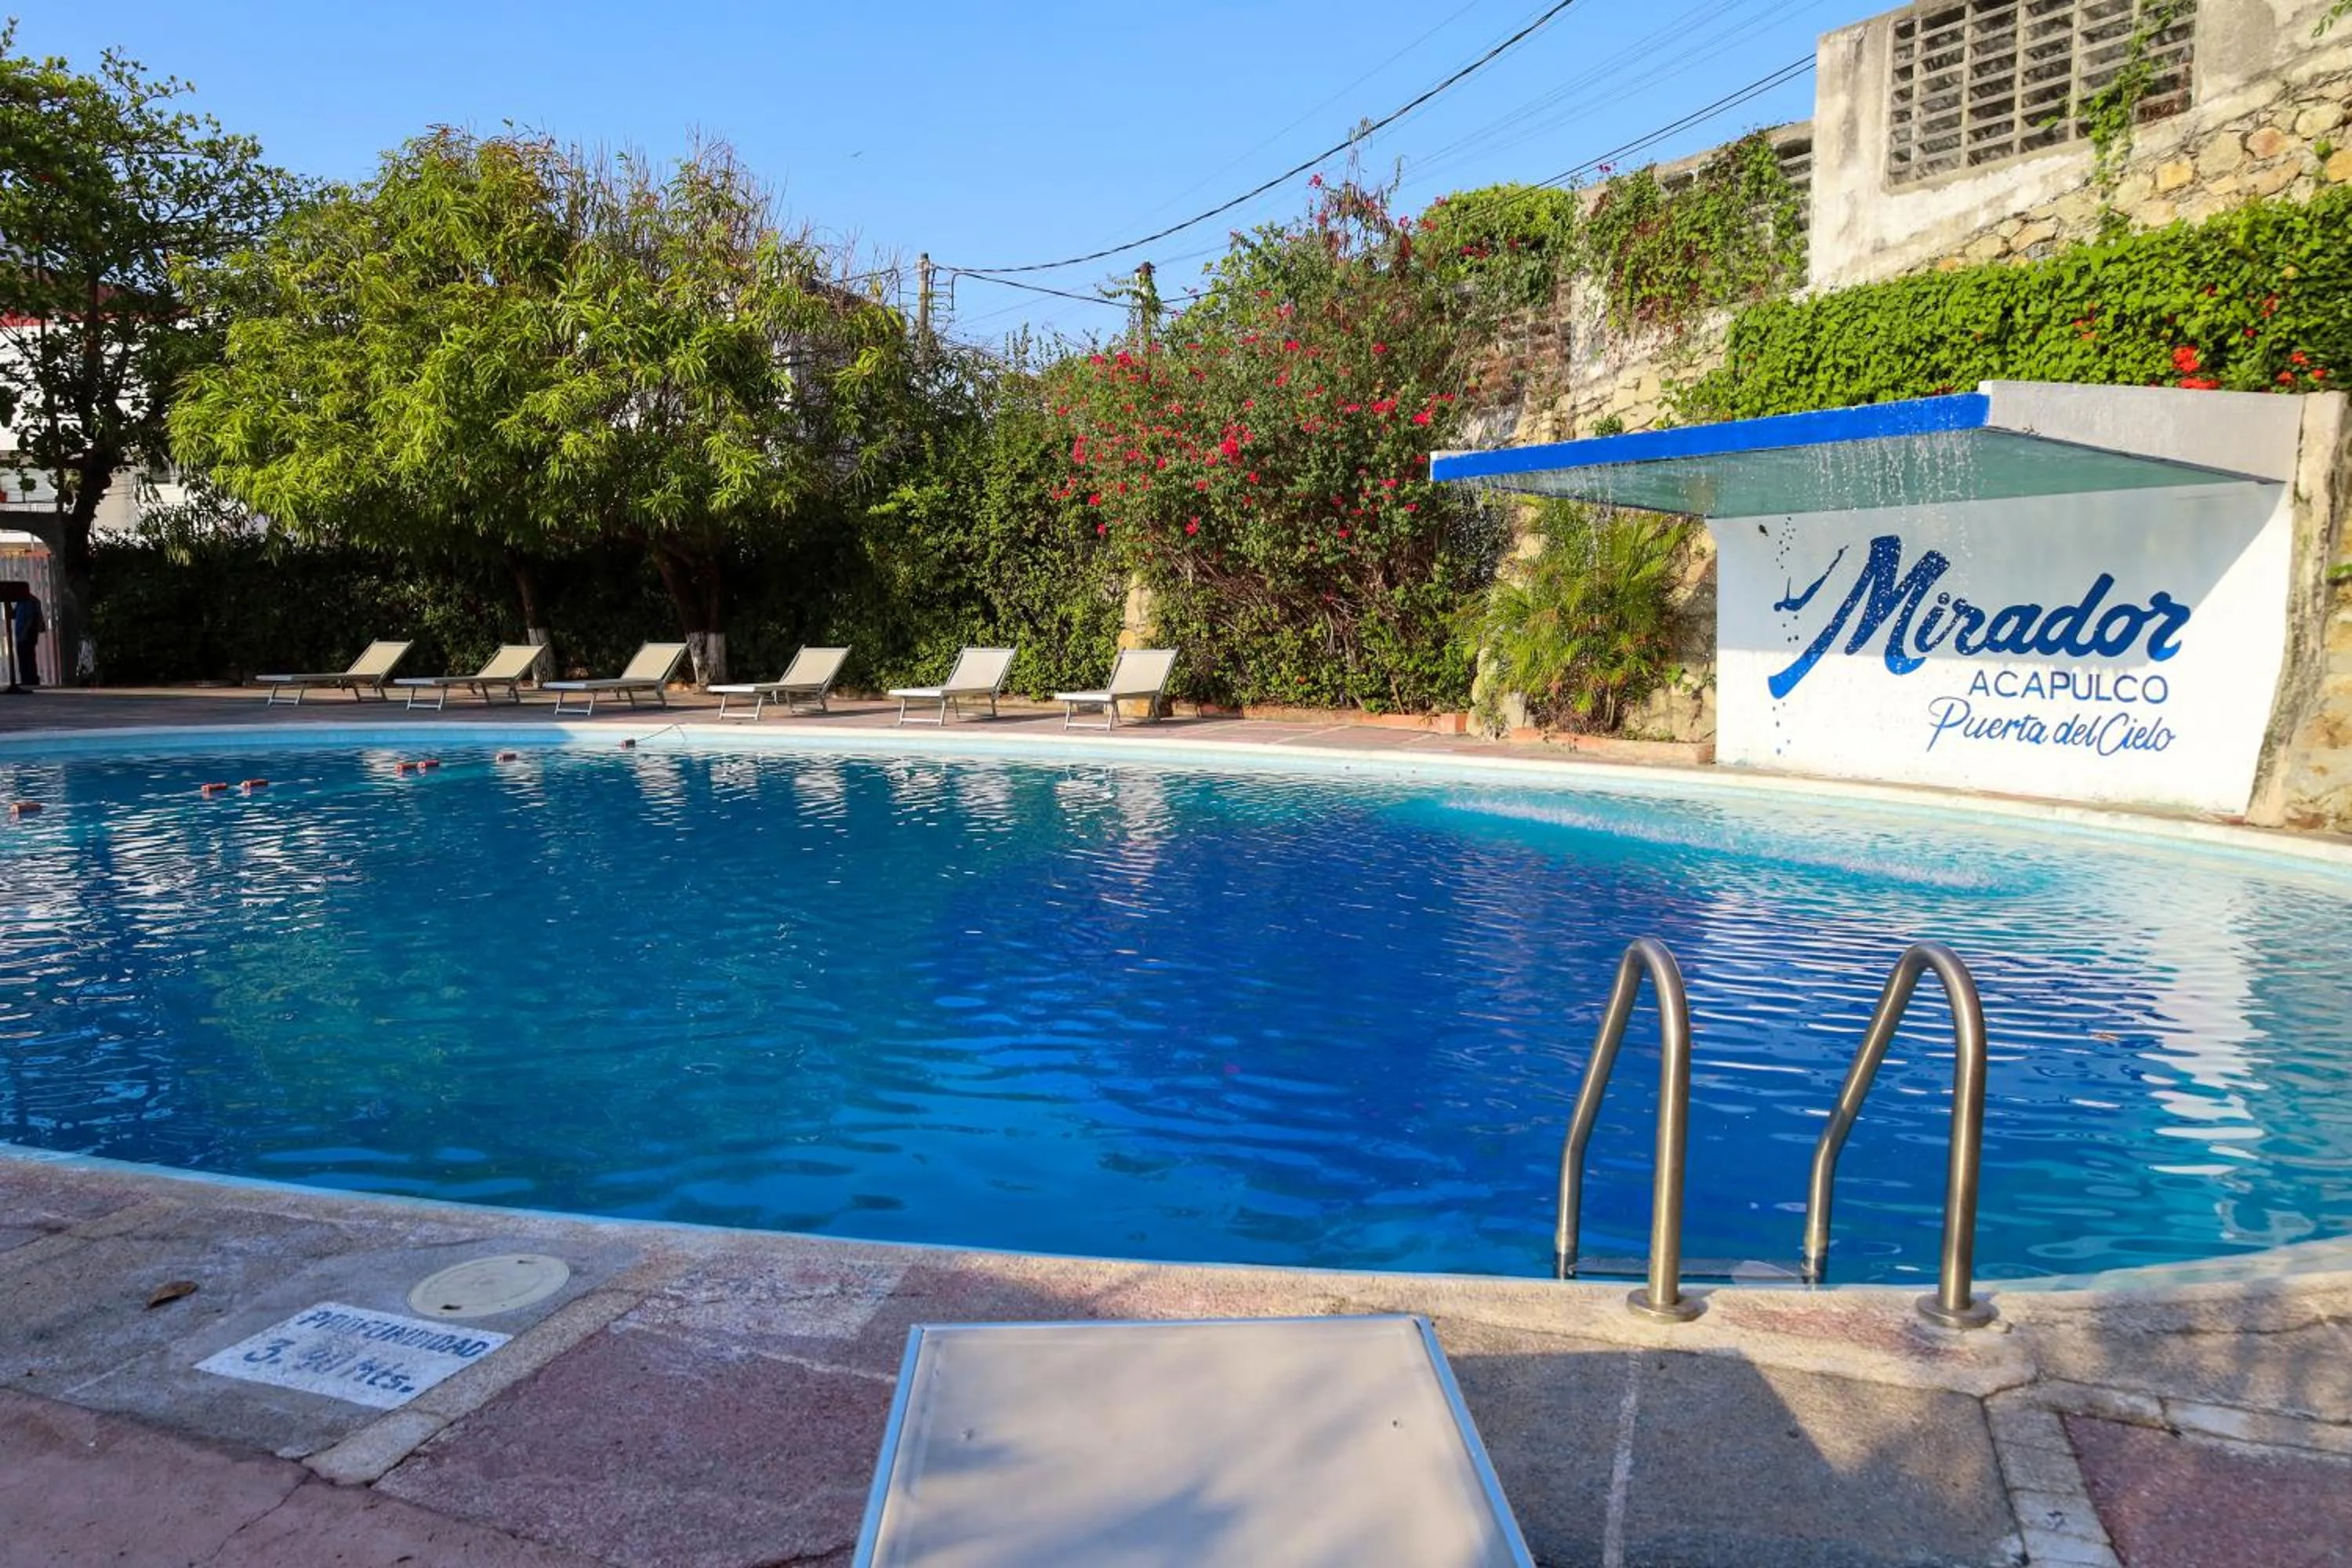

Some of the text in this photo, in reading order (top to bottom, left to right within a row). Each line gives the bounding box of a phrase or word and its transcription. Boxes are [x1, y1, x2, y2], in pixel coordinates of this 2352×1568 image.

[1769, 535, 2190, 699] Mirador
[1969, 670, 2169, 703] ACAPULCO
[1927, 696, 2176, 756] Puerta del Cielo
